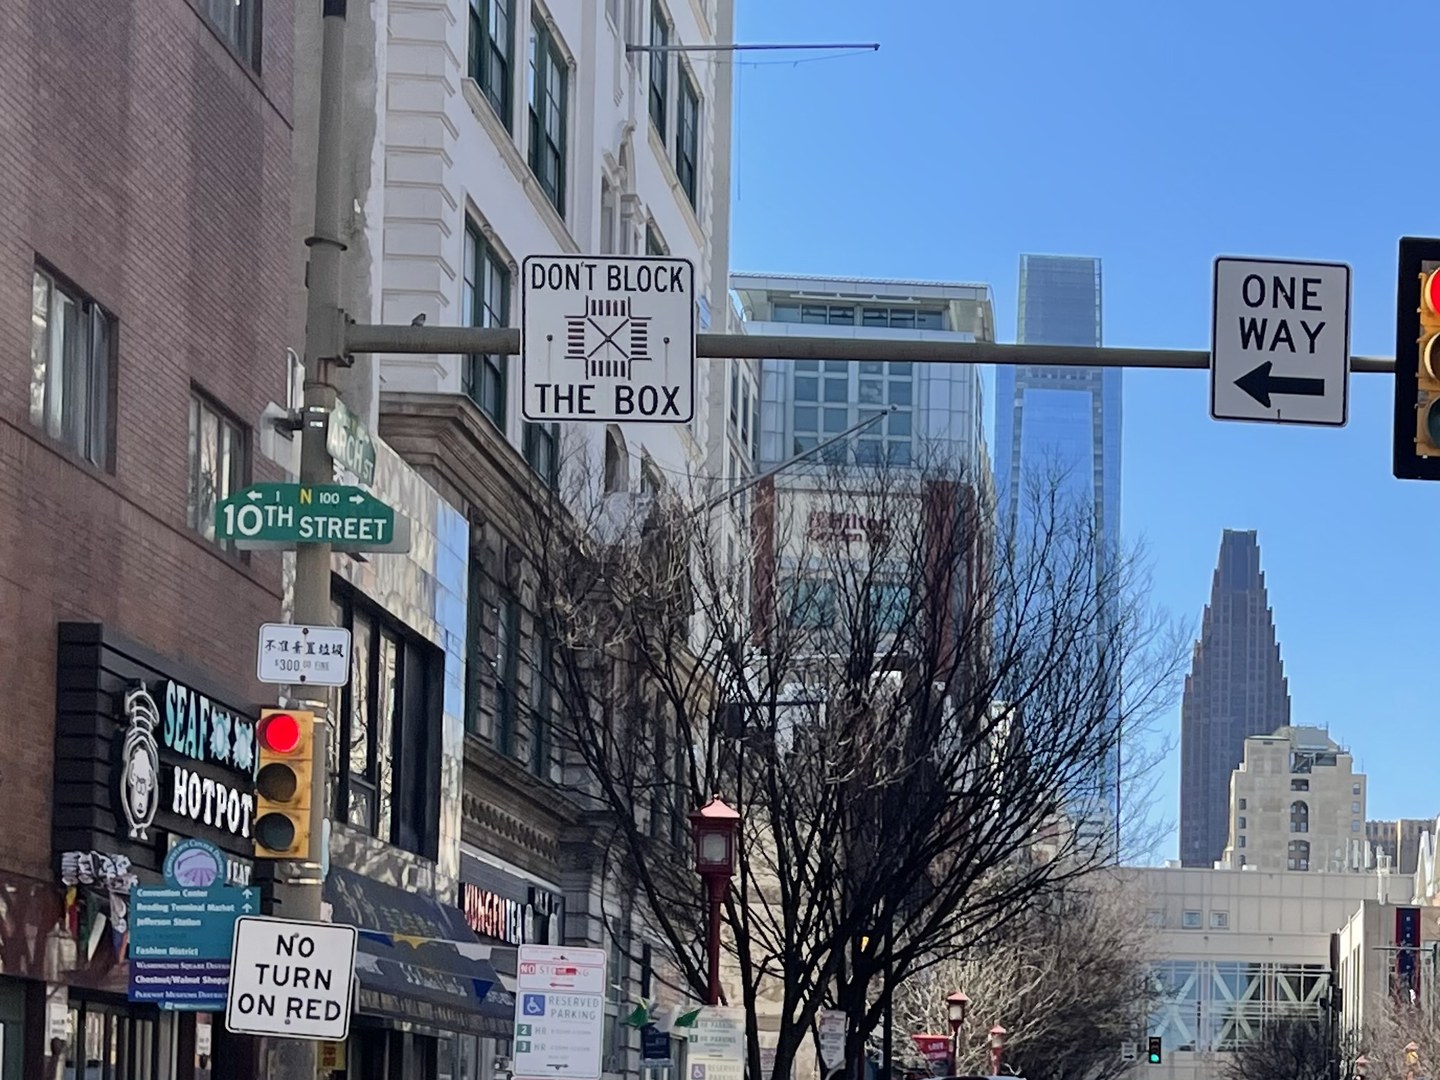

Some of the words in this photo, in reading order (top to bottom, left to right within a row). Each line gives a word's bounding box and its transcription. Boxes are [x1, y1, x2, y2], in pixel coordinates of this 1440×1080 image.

[531, 261, 597, 290] DON'T
[607, 265, 684, 293] BLOCK
[1242, 274, 1322, 312] ONE
[1239, 316, 1326, 354] WAY
[534, 384, 596, 414] THE
[615, 385, 680, 416] BOX
[300, 488, 312, 504] N
[319, 492, 340, 504] 100
[223, 503, 294, 536] 10TH
[299, 516, 387, 540] STREET
[172, 765, 254, 839] HOTPOT
[136, 888, 181, 898] Convention
[182, 888, 208, 897] Center
[207, 903, 235, 912] Market
[135, 946, 168, 955] Fashion
[168, 946, 199, 956] District
[276, 934, 315, 958] NO
[255, 963, 332, 991] TURN
[238, 992, 276, 1017] ON
[285, 999, 341, 1021] RED
[548, 996, 600, 1008] RESERVED
[550, 1008, 597, 1020] PARKING
